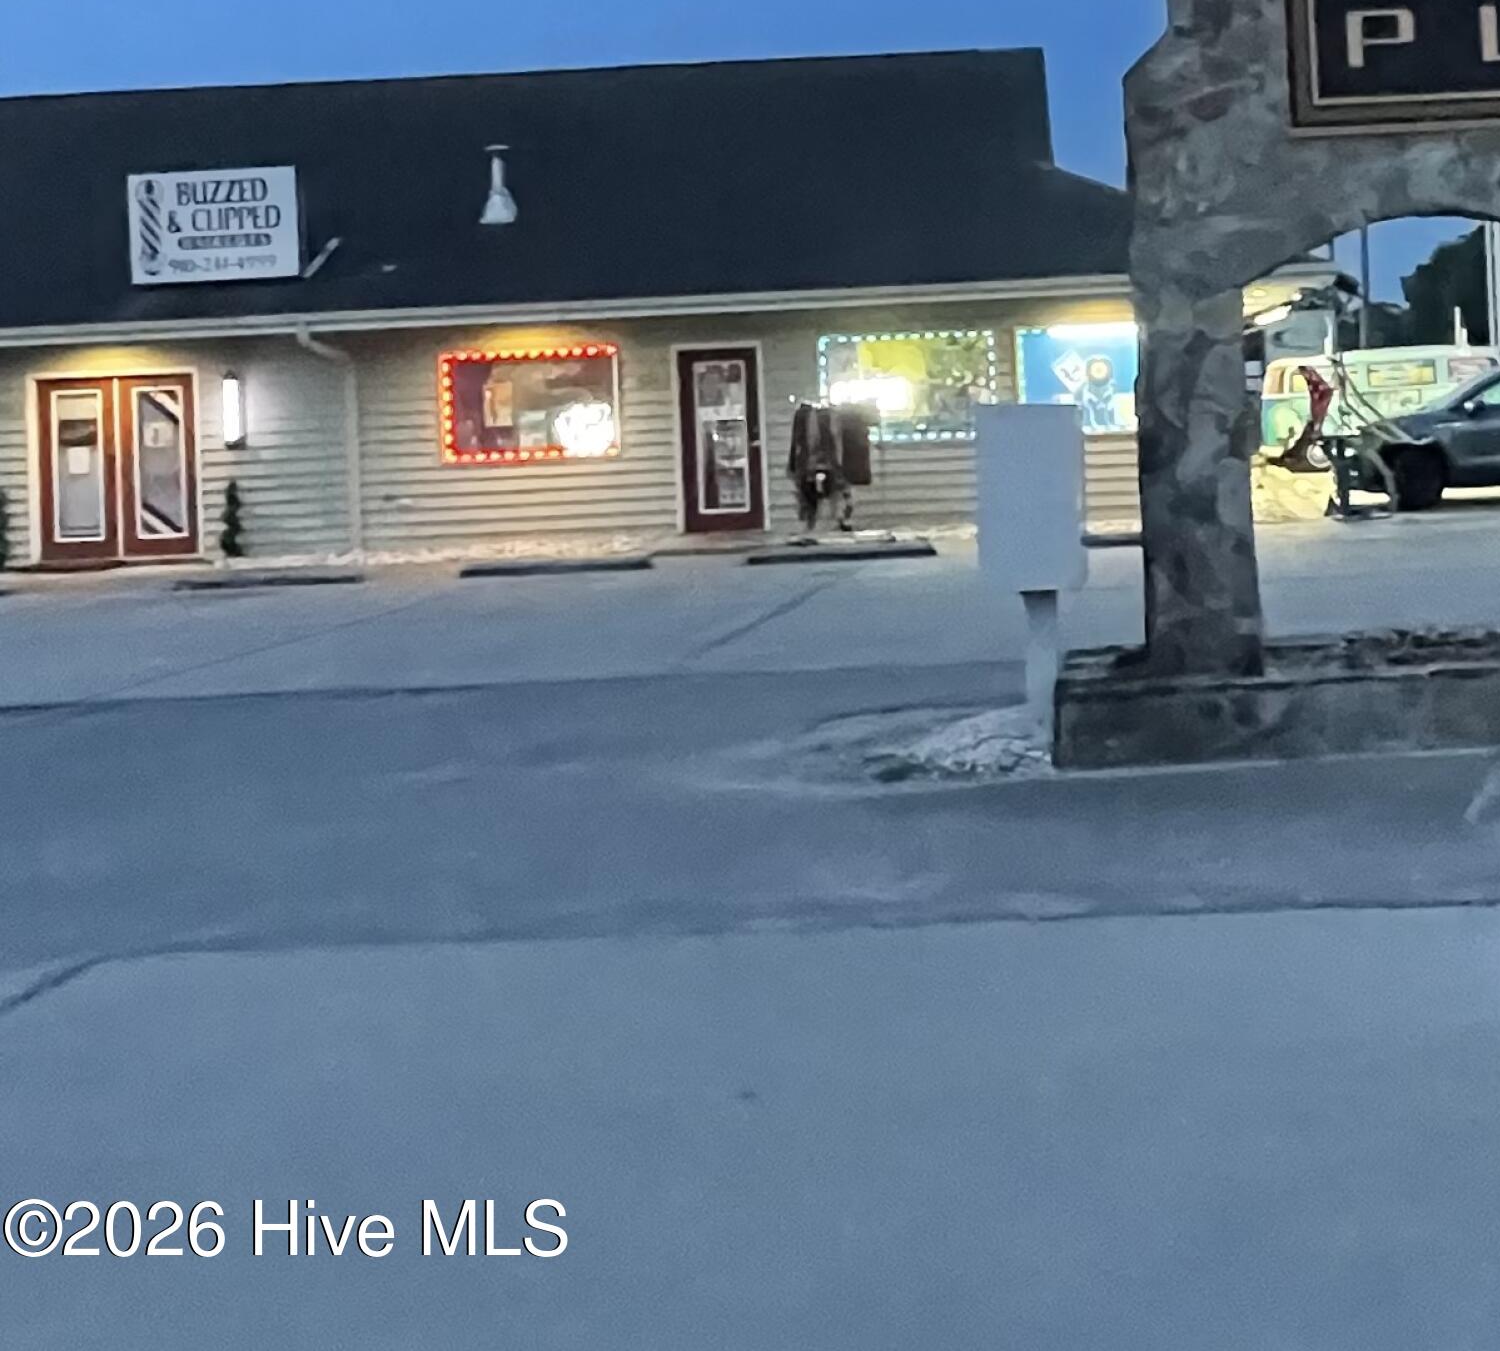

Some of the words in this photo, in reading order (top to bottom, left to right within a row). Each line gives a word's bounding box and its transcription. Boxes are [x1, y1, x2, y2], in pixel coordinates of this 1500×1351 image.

[175, 177, 269, 207] BUZZED
[167, 210, 182, 233] &
[191, 204, 281, 232] CLIPPED
